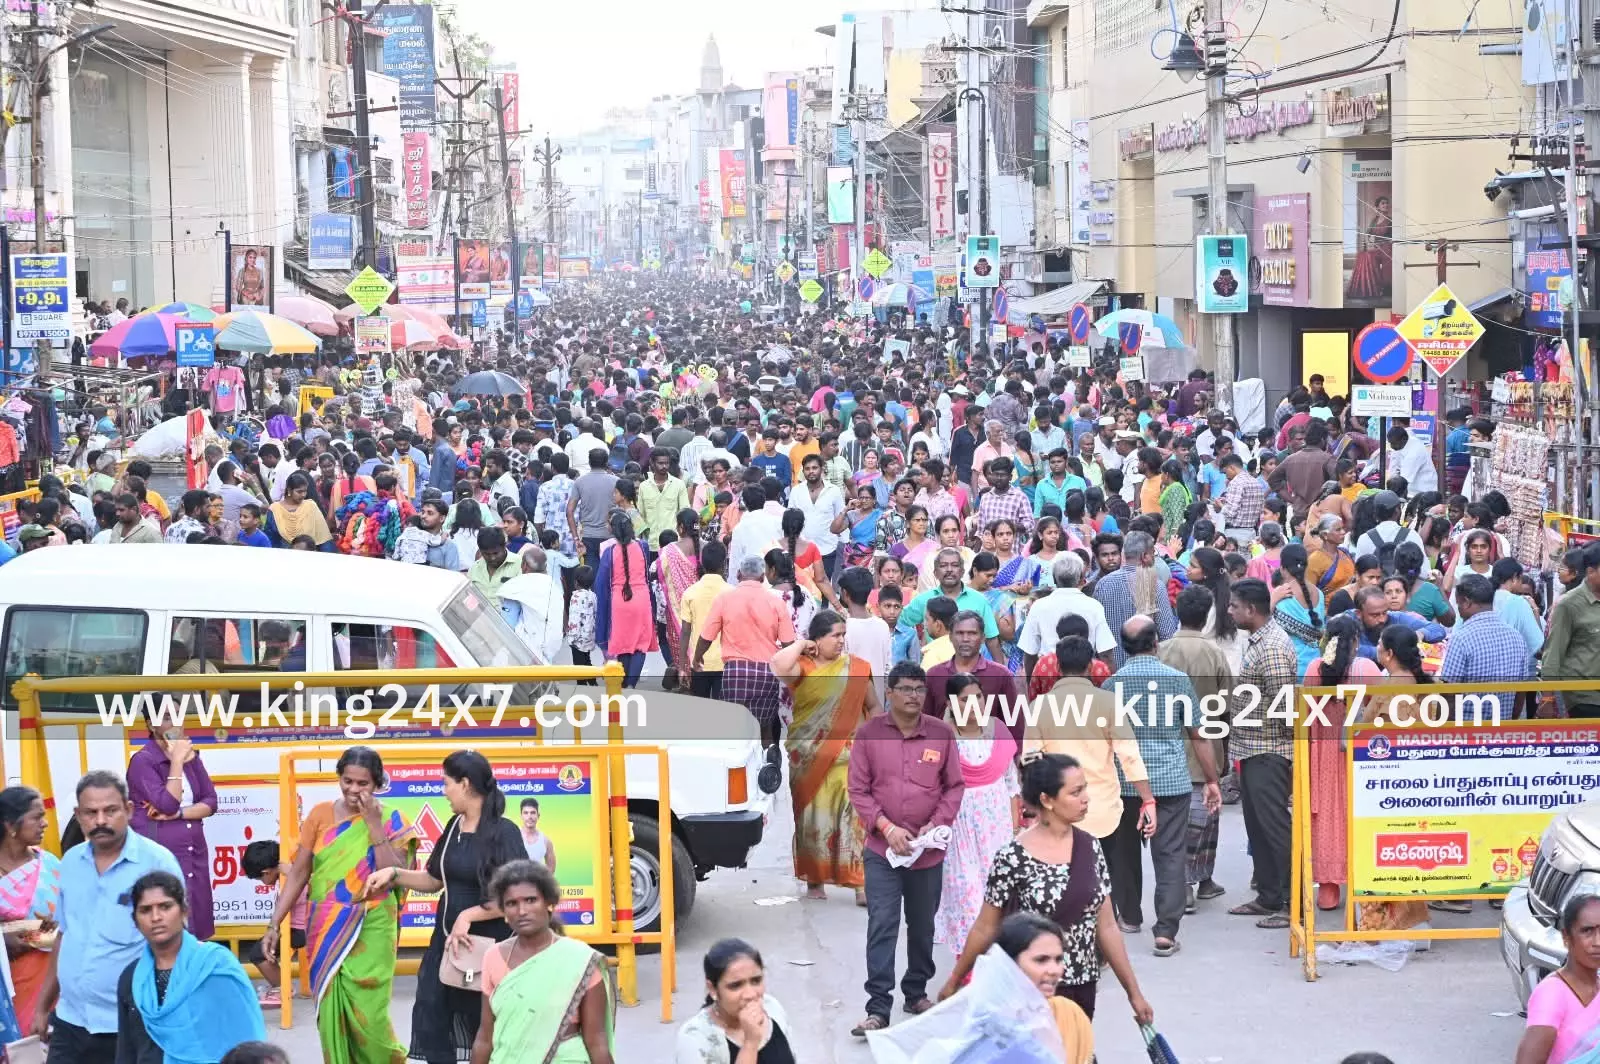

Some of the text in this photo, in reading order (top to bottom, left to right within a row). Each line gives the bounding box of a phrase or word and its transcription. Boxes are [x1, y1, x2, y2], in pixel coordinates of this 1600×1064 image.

[178, 330, 194, 352] P
[1366, 337, 1400, 367] NO PARKING
[1397, 729, 1599, 747] MADURAI TRAFFIC POLICE
[1396, 744, 1600, 760] மதுரை போக்குவரத்து காவல்
[1365, 771, 1600, 793] சாலை பாதுகாப்பு என்பது
[1379, 792, 1498, 809] அனைவரின்
[213, 900, 248, 911] 0951
